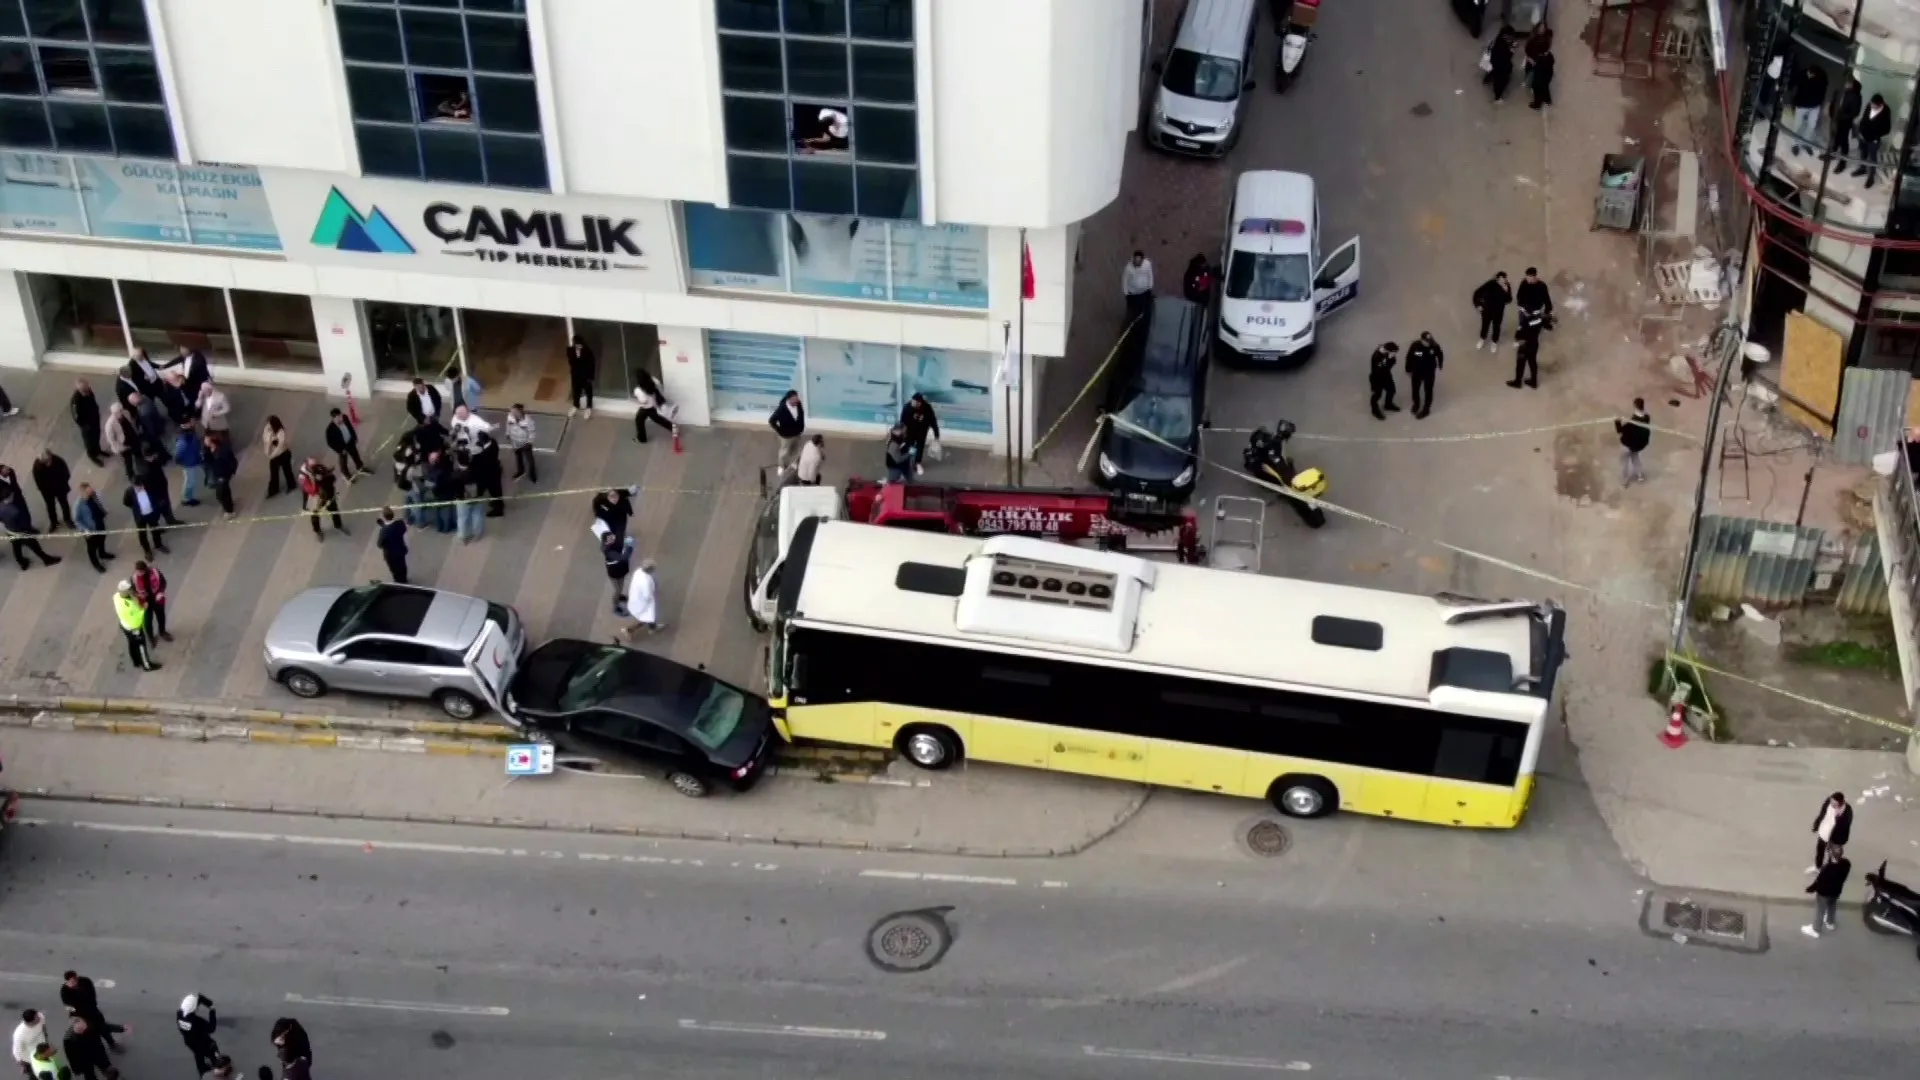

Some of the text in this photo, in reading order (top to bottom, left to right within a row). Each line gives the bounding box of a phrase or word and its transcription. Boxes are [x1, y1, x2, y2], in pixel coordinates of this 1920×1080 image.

[422, 201, 644, 256] ÇAMLIK
[475, 248, 509, 263] TIP
[981, 510, 1073, 522] KIRALIK
